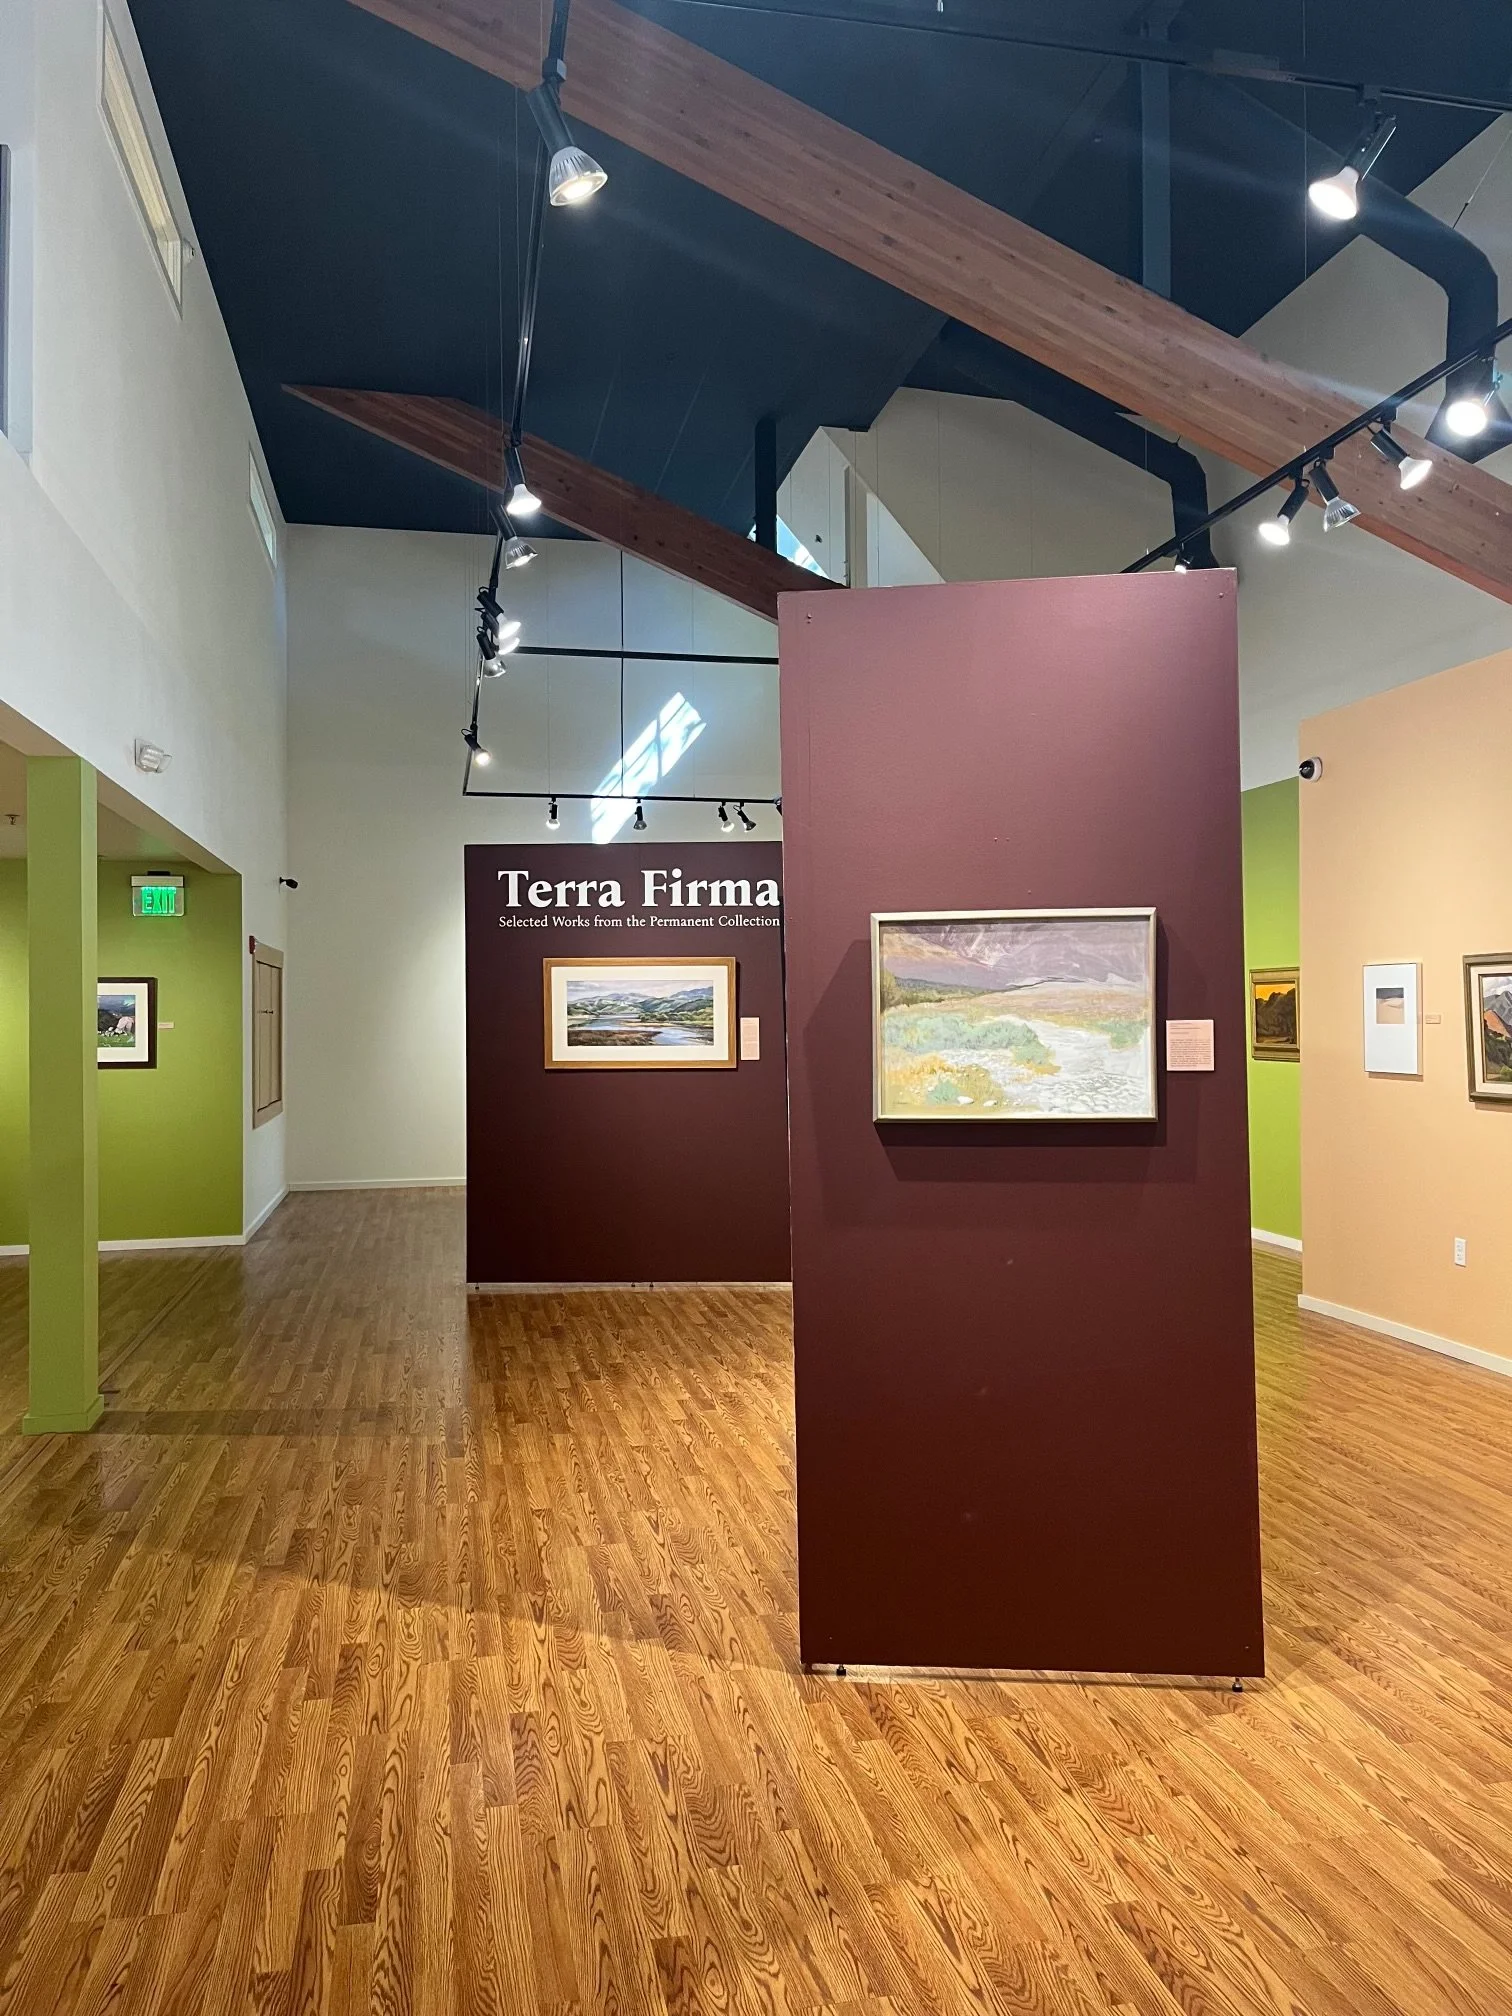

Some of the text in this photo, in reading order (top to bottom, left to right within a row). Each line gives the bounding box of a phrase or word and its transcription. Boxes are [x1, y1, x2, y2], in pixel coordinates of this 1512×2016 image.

[141, 887, 176, 913] EXIT
[497, 868, 780, 908] Terra Firma
[498, 914, 780, 927] Selected Works from the Permanent Collection
